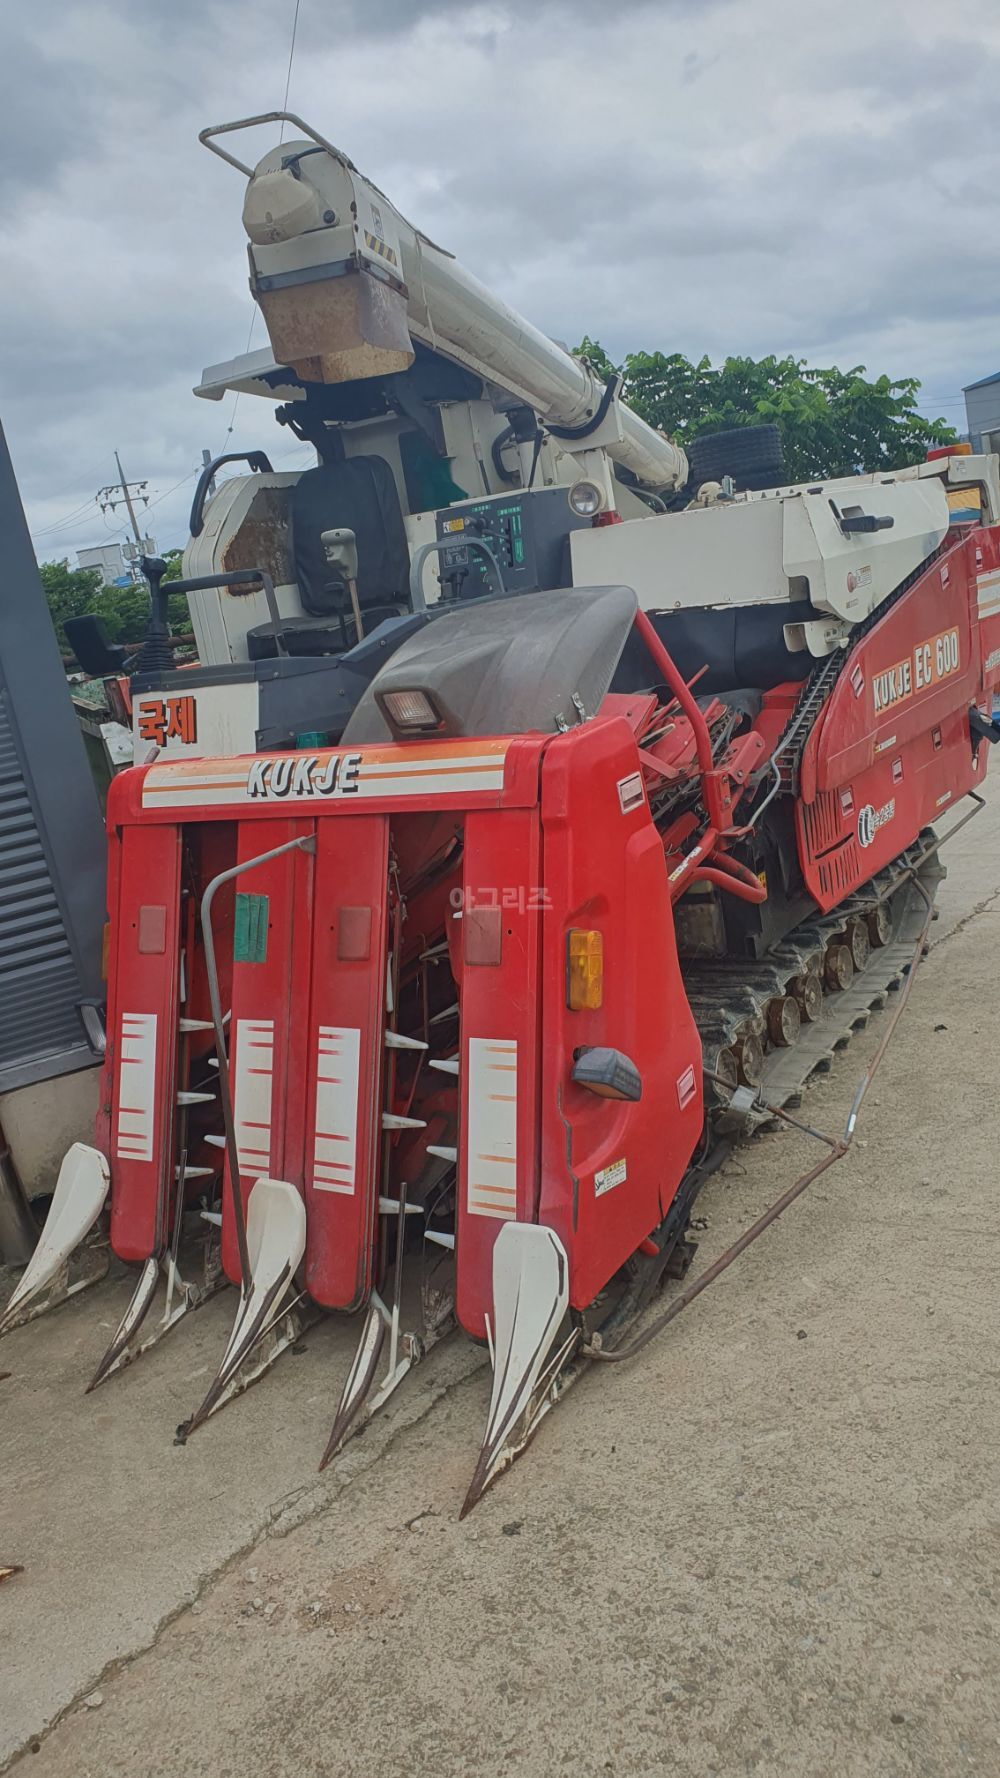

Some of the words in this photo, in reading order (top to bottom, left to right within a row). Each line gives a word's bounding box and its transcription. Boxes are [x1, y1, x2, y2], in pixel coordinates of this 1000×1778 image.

[873, 662, 910, 710] KUKJE
[914, 644, 931, 689] EC
[936, 632, 958, 677] 600
[138, 696, 197, 747] 국제
[247, 753, 362, 797] KUKJE
